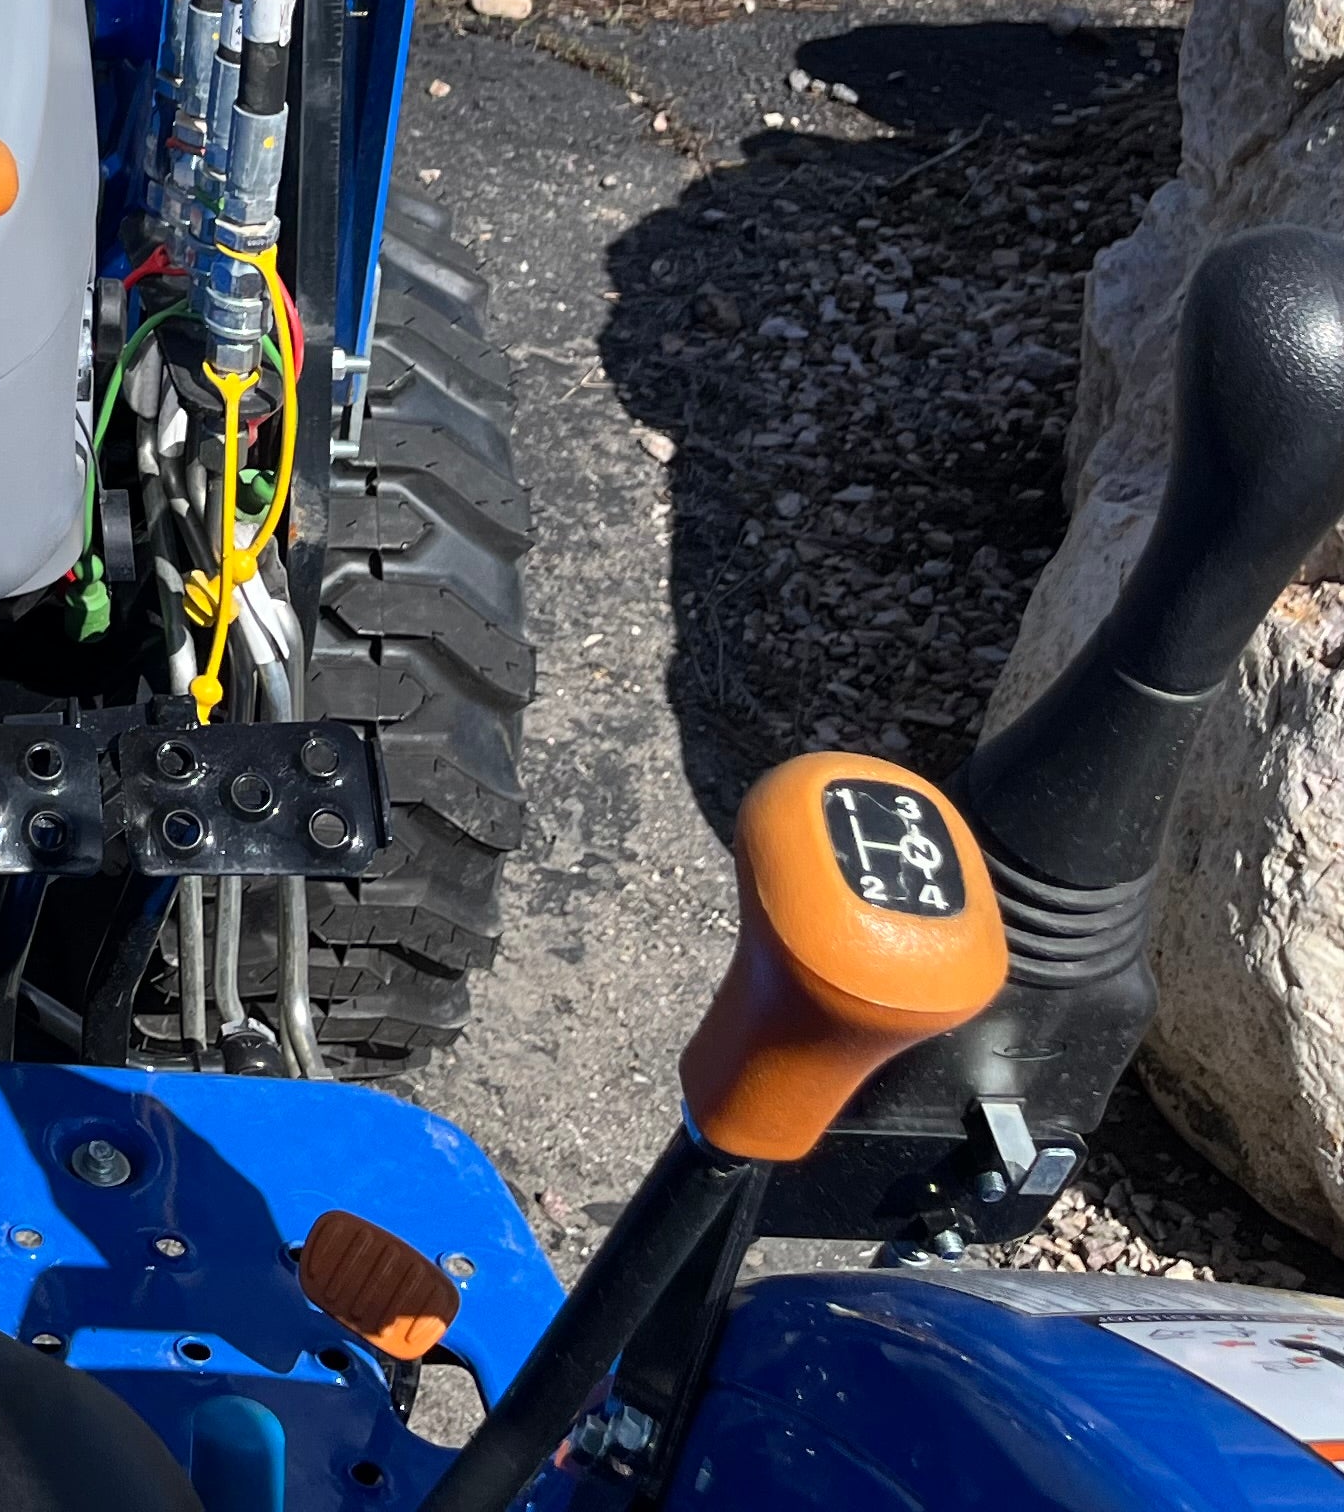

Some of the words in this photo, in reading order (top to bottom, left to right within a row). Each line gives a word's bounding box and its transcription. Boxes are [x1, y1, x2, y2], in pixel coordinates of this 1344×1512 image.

[835, 788, 855, 810] 1
[894, 795, 922, 821] 3
[859, 874, 889, 902] 2
[918, 883, 951, 910] 4
